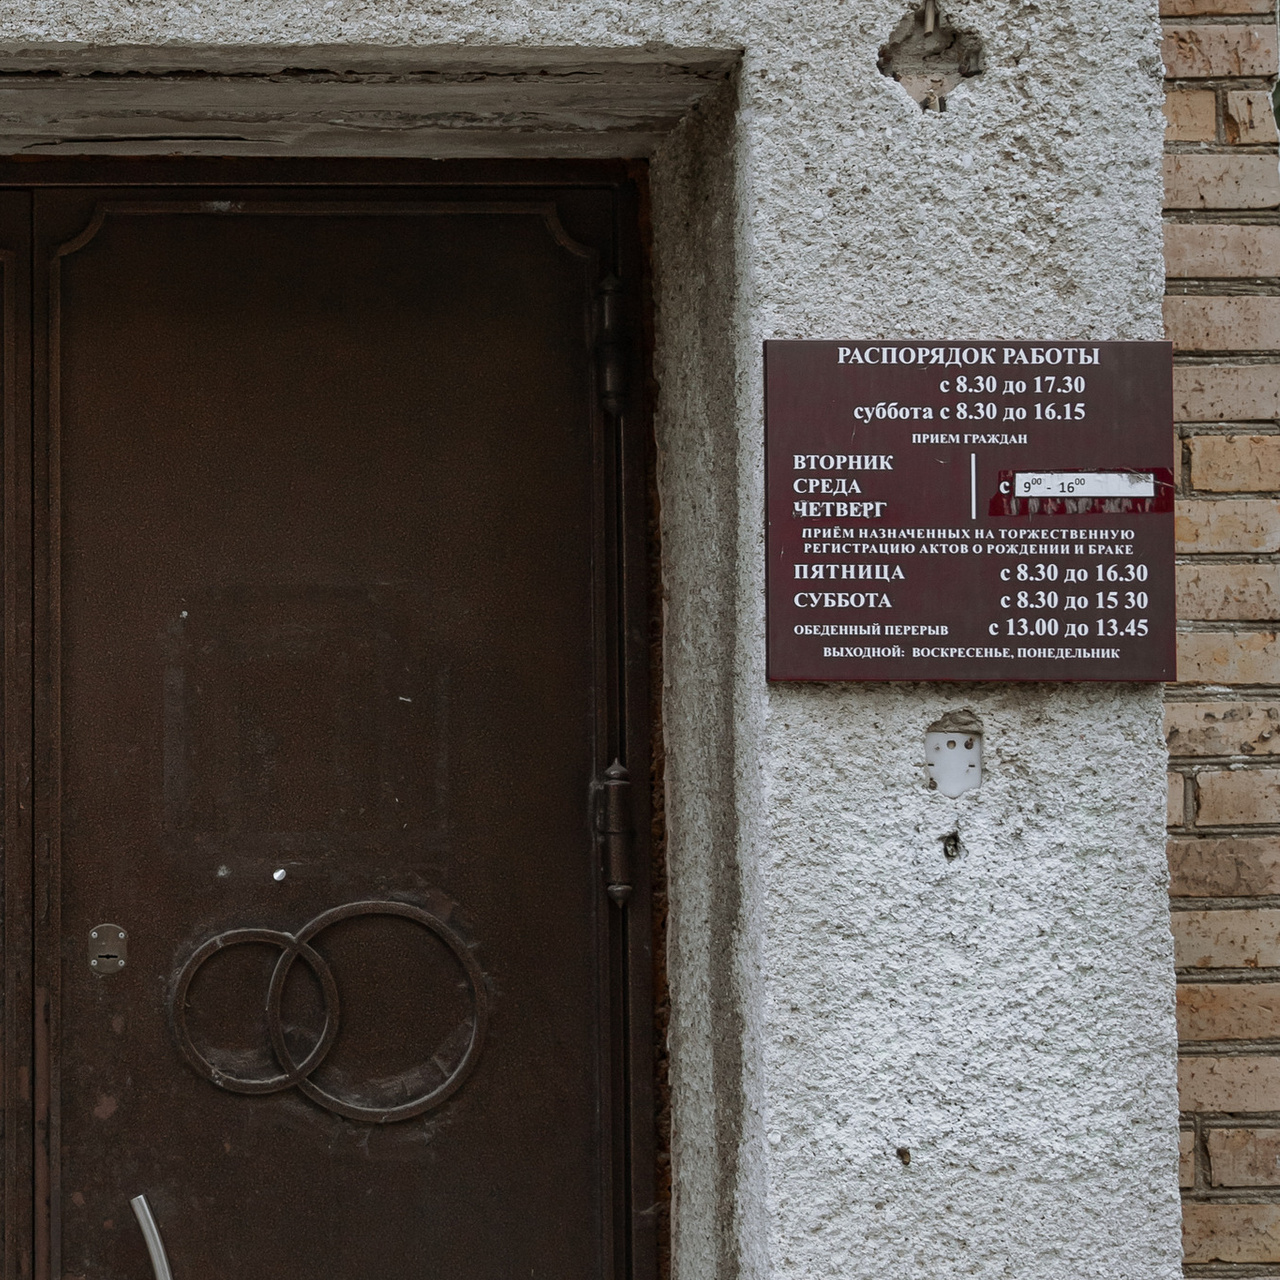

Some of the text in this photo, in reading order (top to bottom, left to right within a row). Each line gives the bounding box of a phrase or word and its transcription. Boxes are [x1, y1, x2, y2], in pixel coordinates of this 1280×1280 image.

[837, 347, 1100, 367] РАСПОРЯДОК РАБОТЫ
[939, 375, 1085, 396] с 8.30 до 17.30
[853, 402, 1086, 423] суббота с 8.30 до 16.15
[912, 433, 1028, 446] ПРИЕМ ГРАЖДАН
[793, 455, 894, 470] ВТОРНИК
[793, 478, 862, 497] СРЕДА
[999, 480, 1010, 494] с
[793, 501, 887, 519] ЧЕТВЕРГ
[802, 525, 1135, 540] ПРИЁМ НАЗНАЧЕННЫХ НА ТОРЖЕСТВЕННУЮ
[803, 543, 1134, 556] РЕГИСТРАЦИЮ АКТОВ О РОЖДЕНИИ И БРАКЕ
[793, 564, 1148, 584] ПЯТНИЦА с 8.30 до 16.30
[793, 592, 893, 609] СУББОТА
[1000, 595, 1011, 609] с
[1017, 592, 1058, 609] 8.30
[1063, 595, 1088, 612] до
[793, 618, 1149, 639] ОБЕДЕННЫЙ ПЕРЕРЫВ с 13.00 до 13.45
[823, 645, 1120, 660] ВЫХОДНОЙ: ВОСКРЕСЕНЬЕ, ПОНЕДЕЛЬНИК
